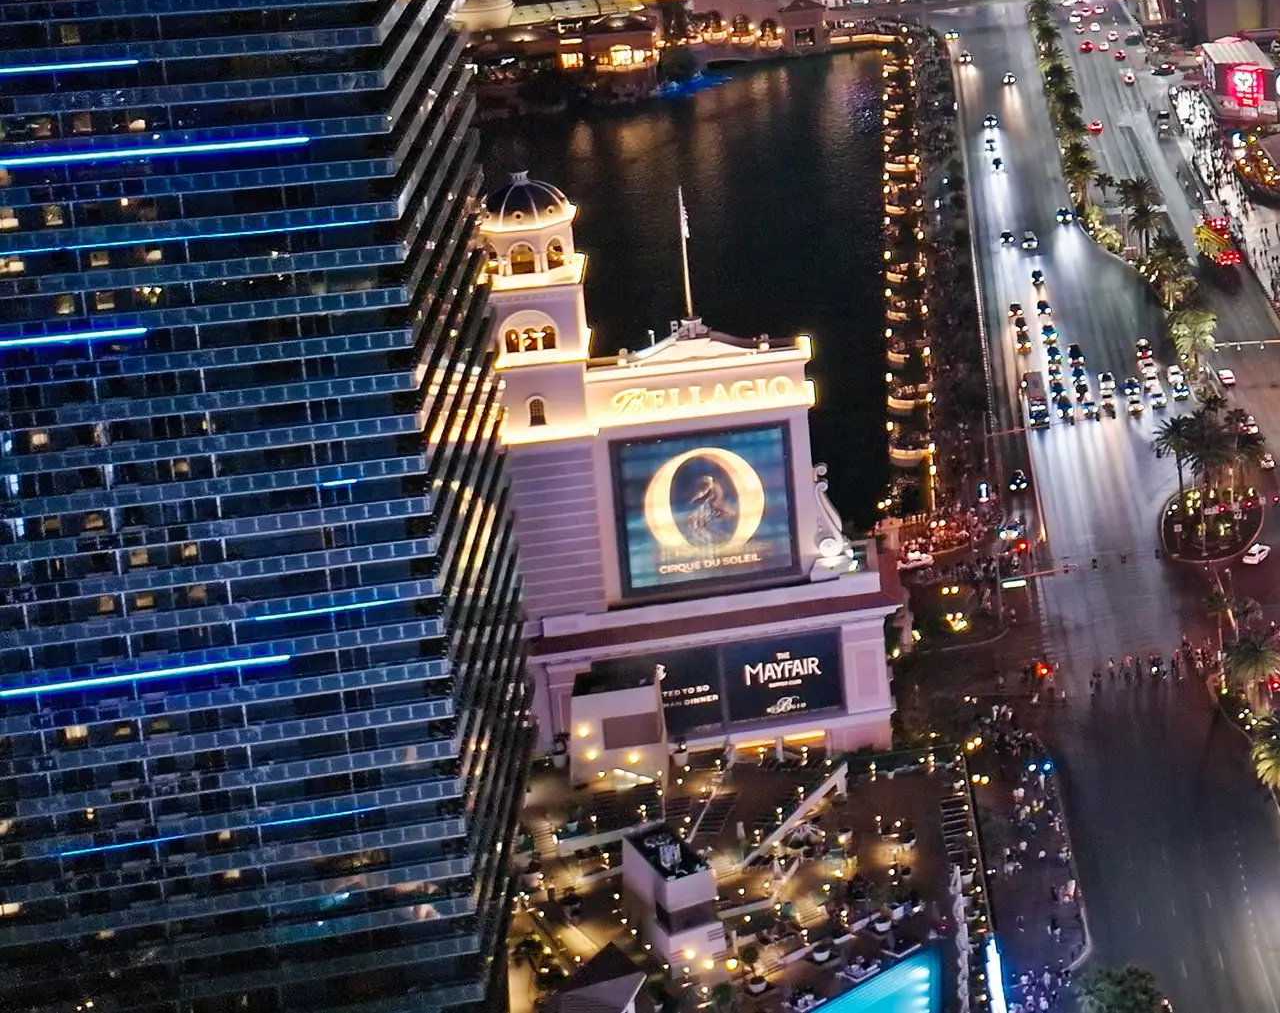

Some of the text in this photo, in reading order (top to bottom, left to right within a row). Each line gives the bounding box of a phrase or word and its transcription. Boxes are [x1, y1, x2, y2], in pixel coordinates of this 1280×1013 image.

[611, 375, 794, 413] BELLAGIO
[643, 446, 766, 552] O
[659, 554, 762, 577] CIRQUE DU SOLEIL
[744, 657, 822, 686] MAYFAIR
[684, 694, 719, 705] DINNER
